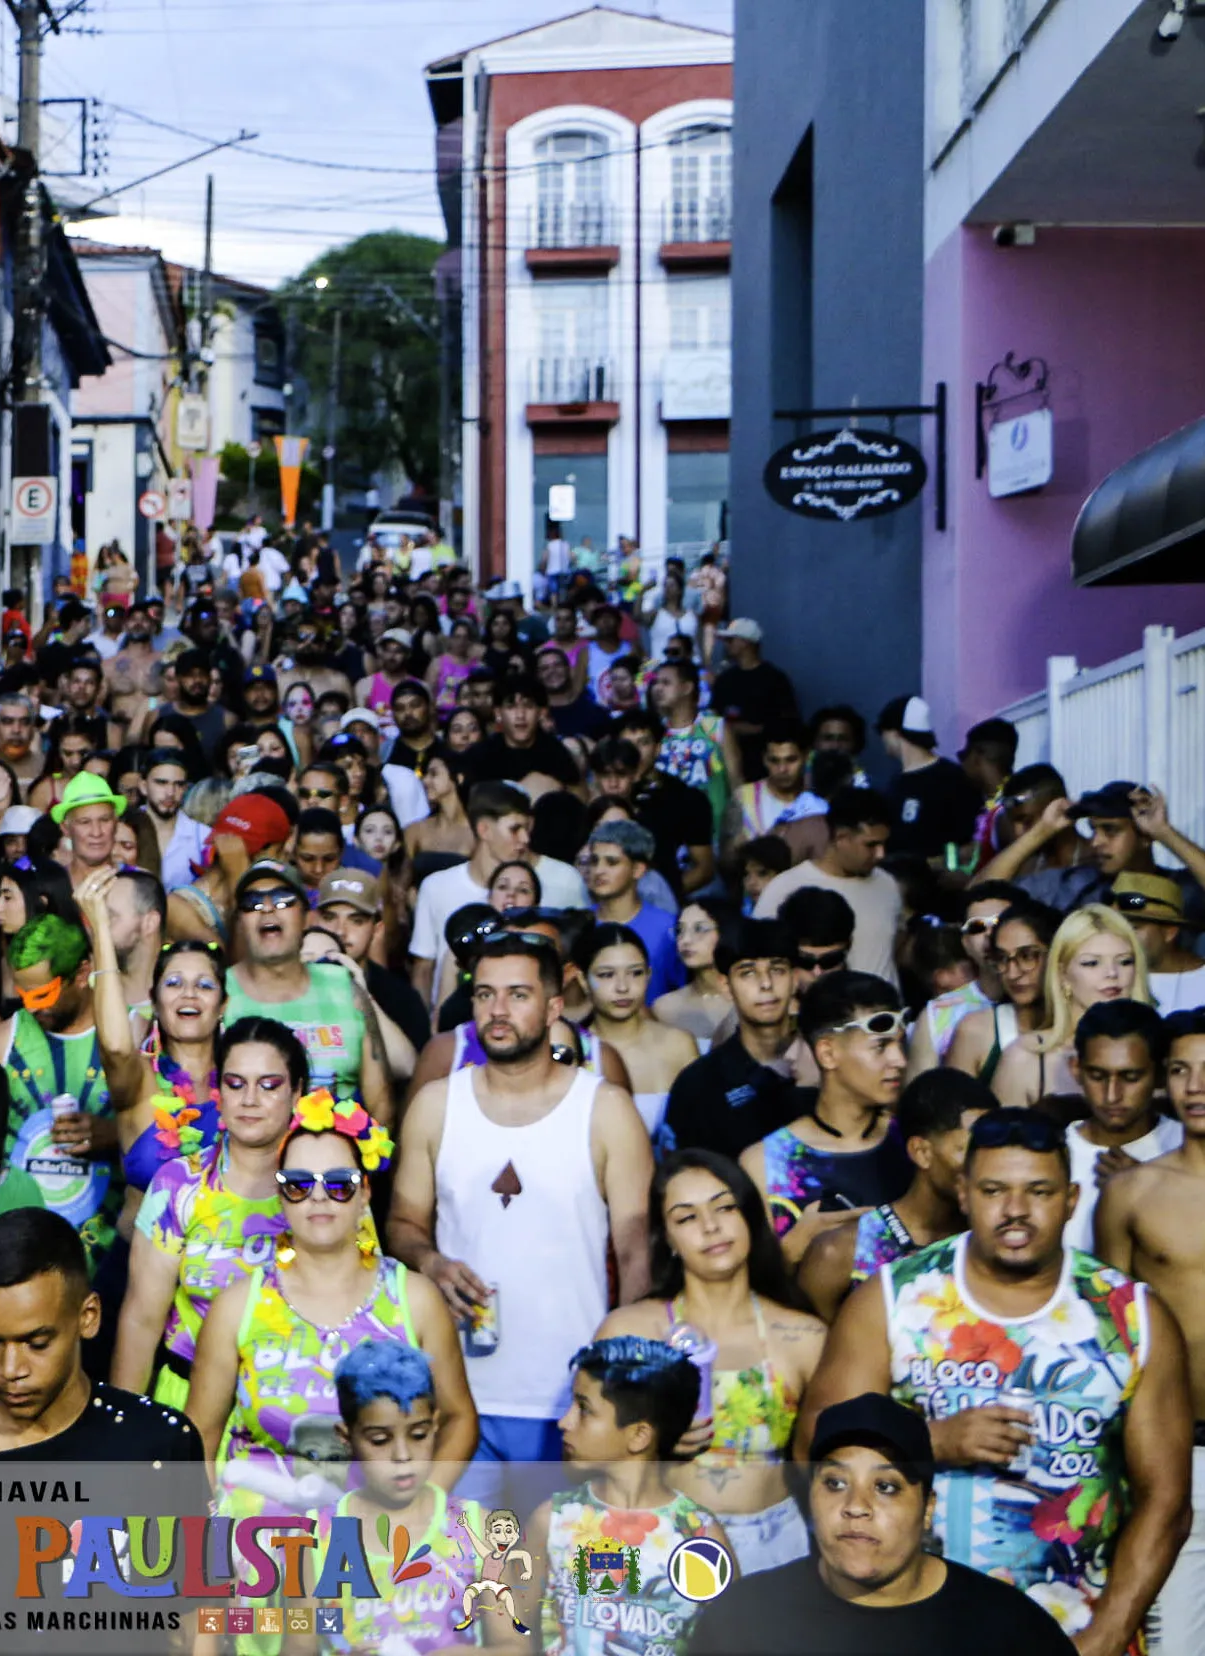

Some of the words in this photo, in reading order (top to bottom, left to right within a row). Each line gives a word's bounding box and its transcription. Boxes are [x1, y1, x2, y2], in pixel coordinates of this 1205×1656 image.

[27, 488, 40, 508] E
[185, 1219, 274, 1264] BLO
[253, 1325, 350, 1371] BLO
[910, 1359, 999, 1388] BLOCO
